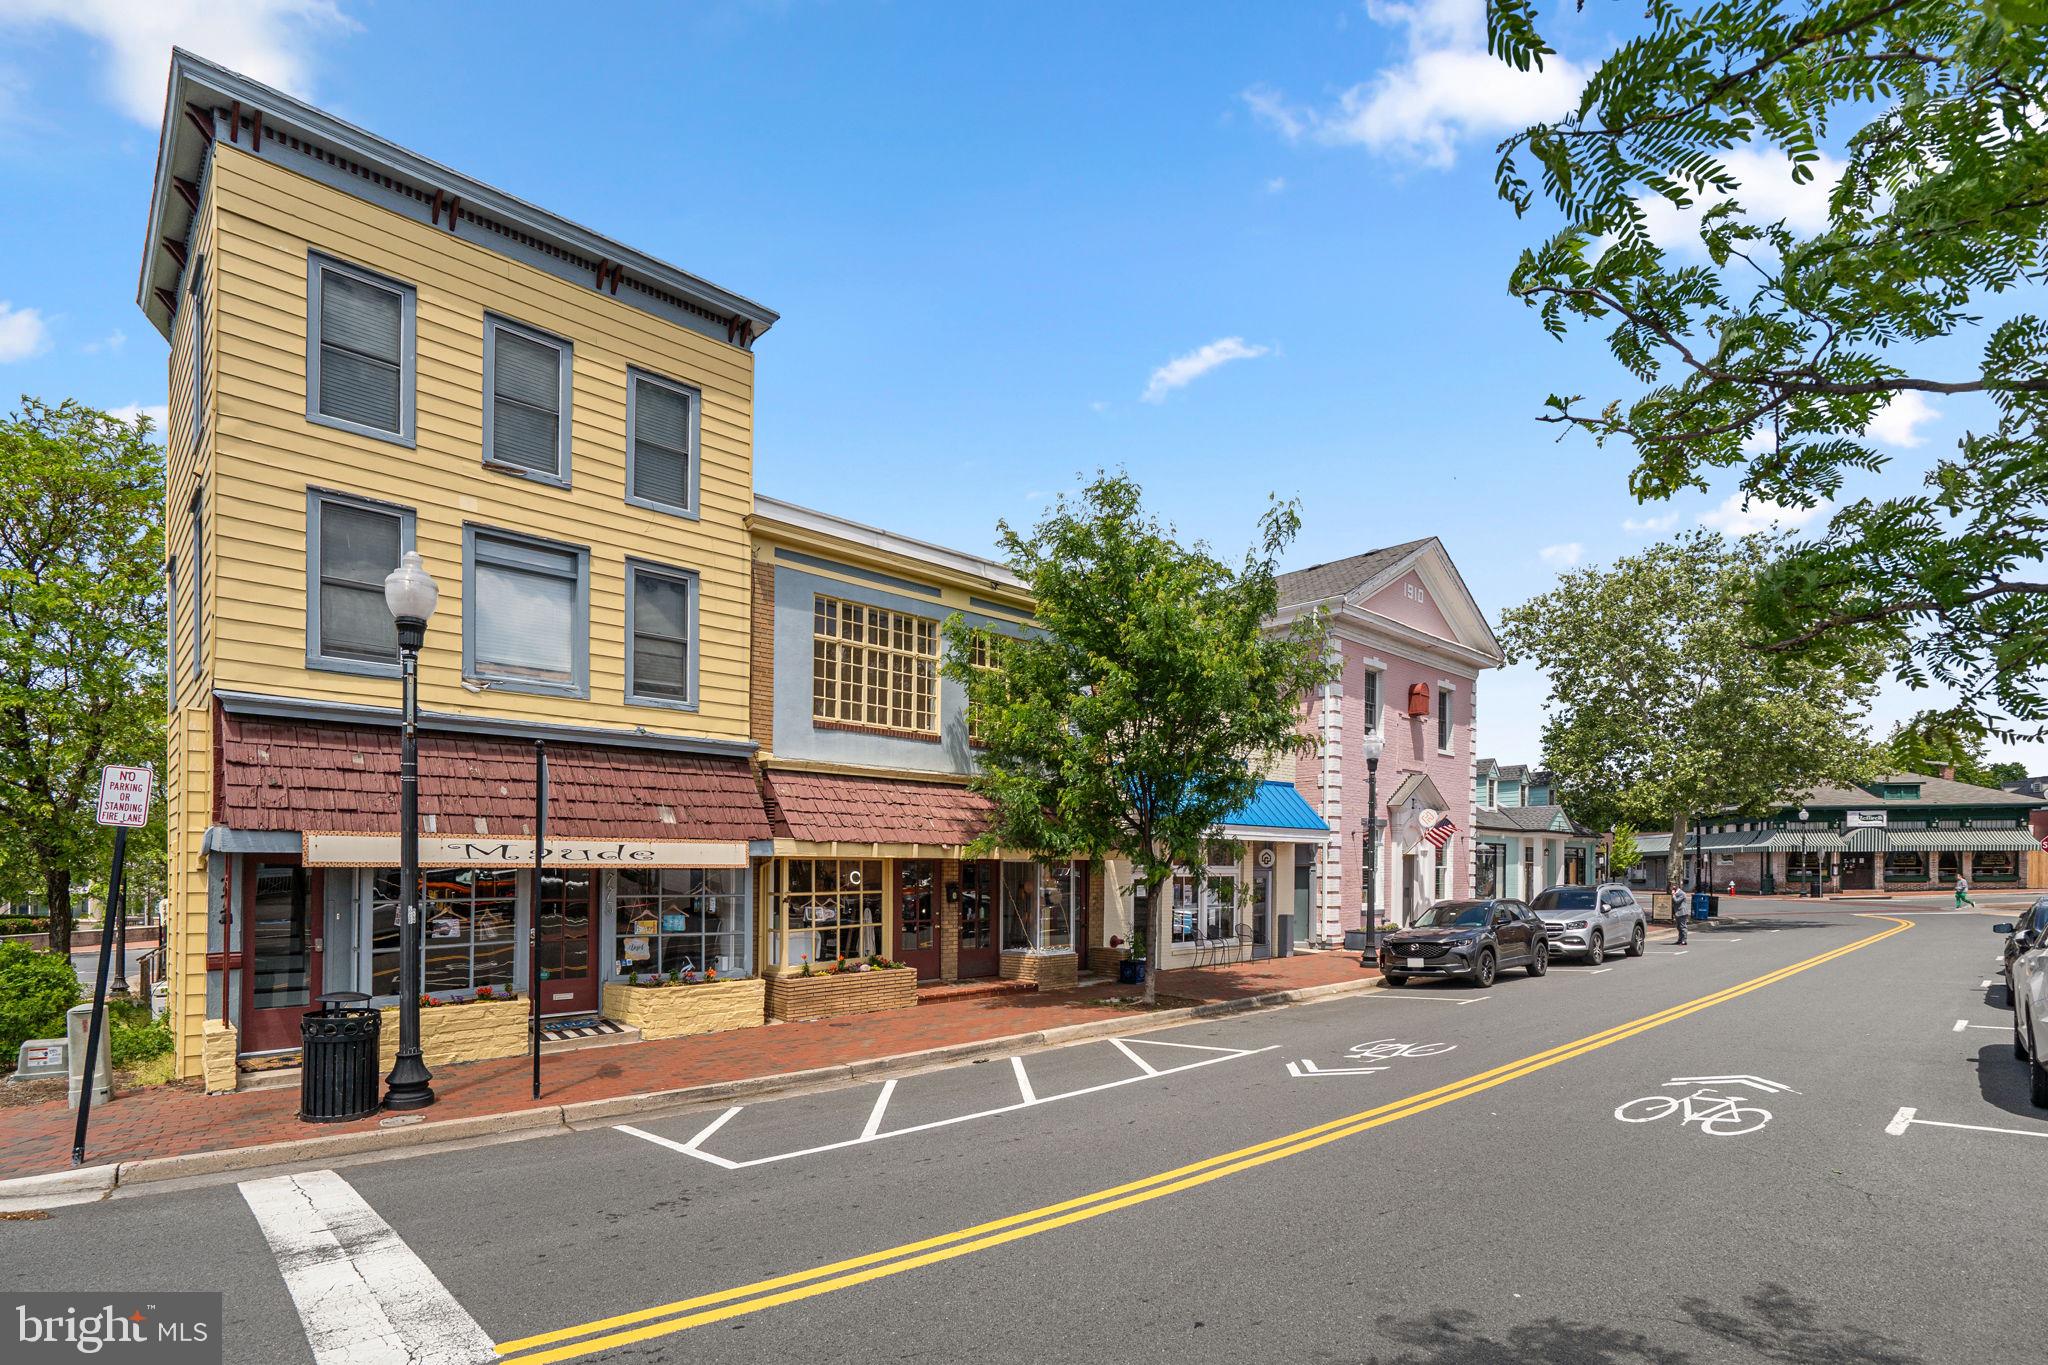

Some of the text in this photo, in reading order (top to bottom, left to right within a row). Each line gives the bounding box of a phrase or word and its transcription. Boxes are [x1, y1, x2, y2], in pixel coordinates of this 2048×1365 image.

[1403, 582, 1424, 604] 1910
[119, 771, 136, 782] NO
[109, 781, 143, 793] PARKING
[119, 792, 131, 802] OR
[104, 801, 143, 813] STANDING
[101, 811, 143, 823] FIRE LANE
